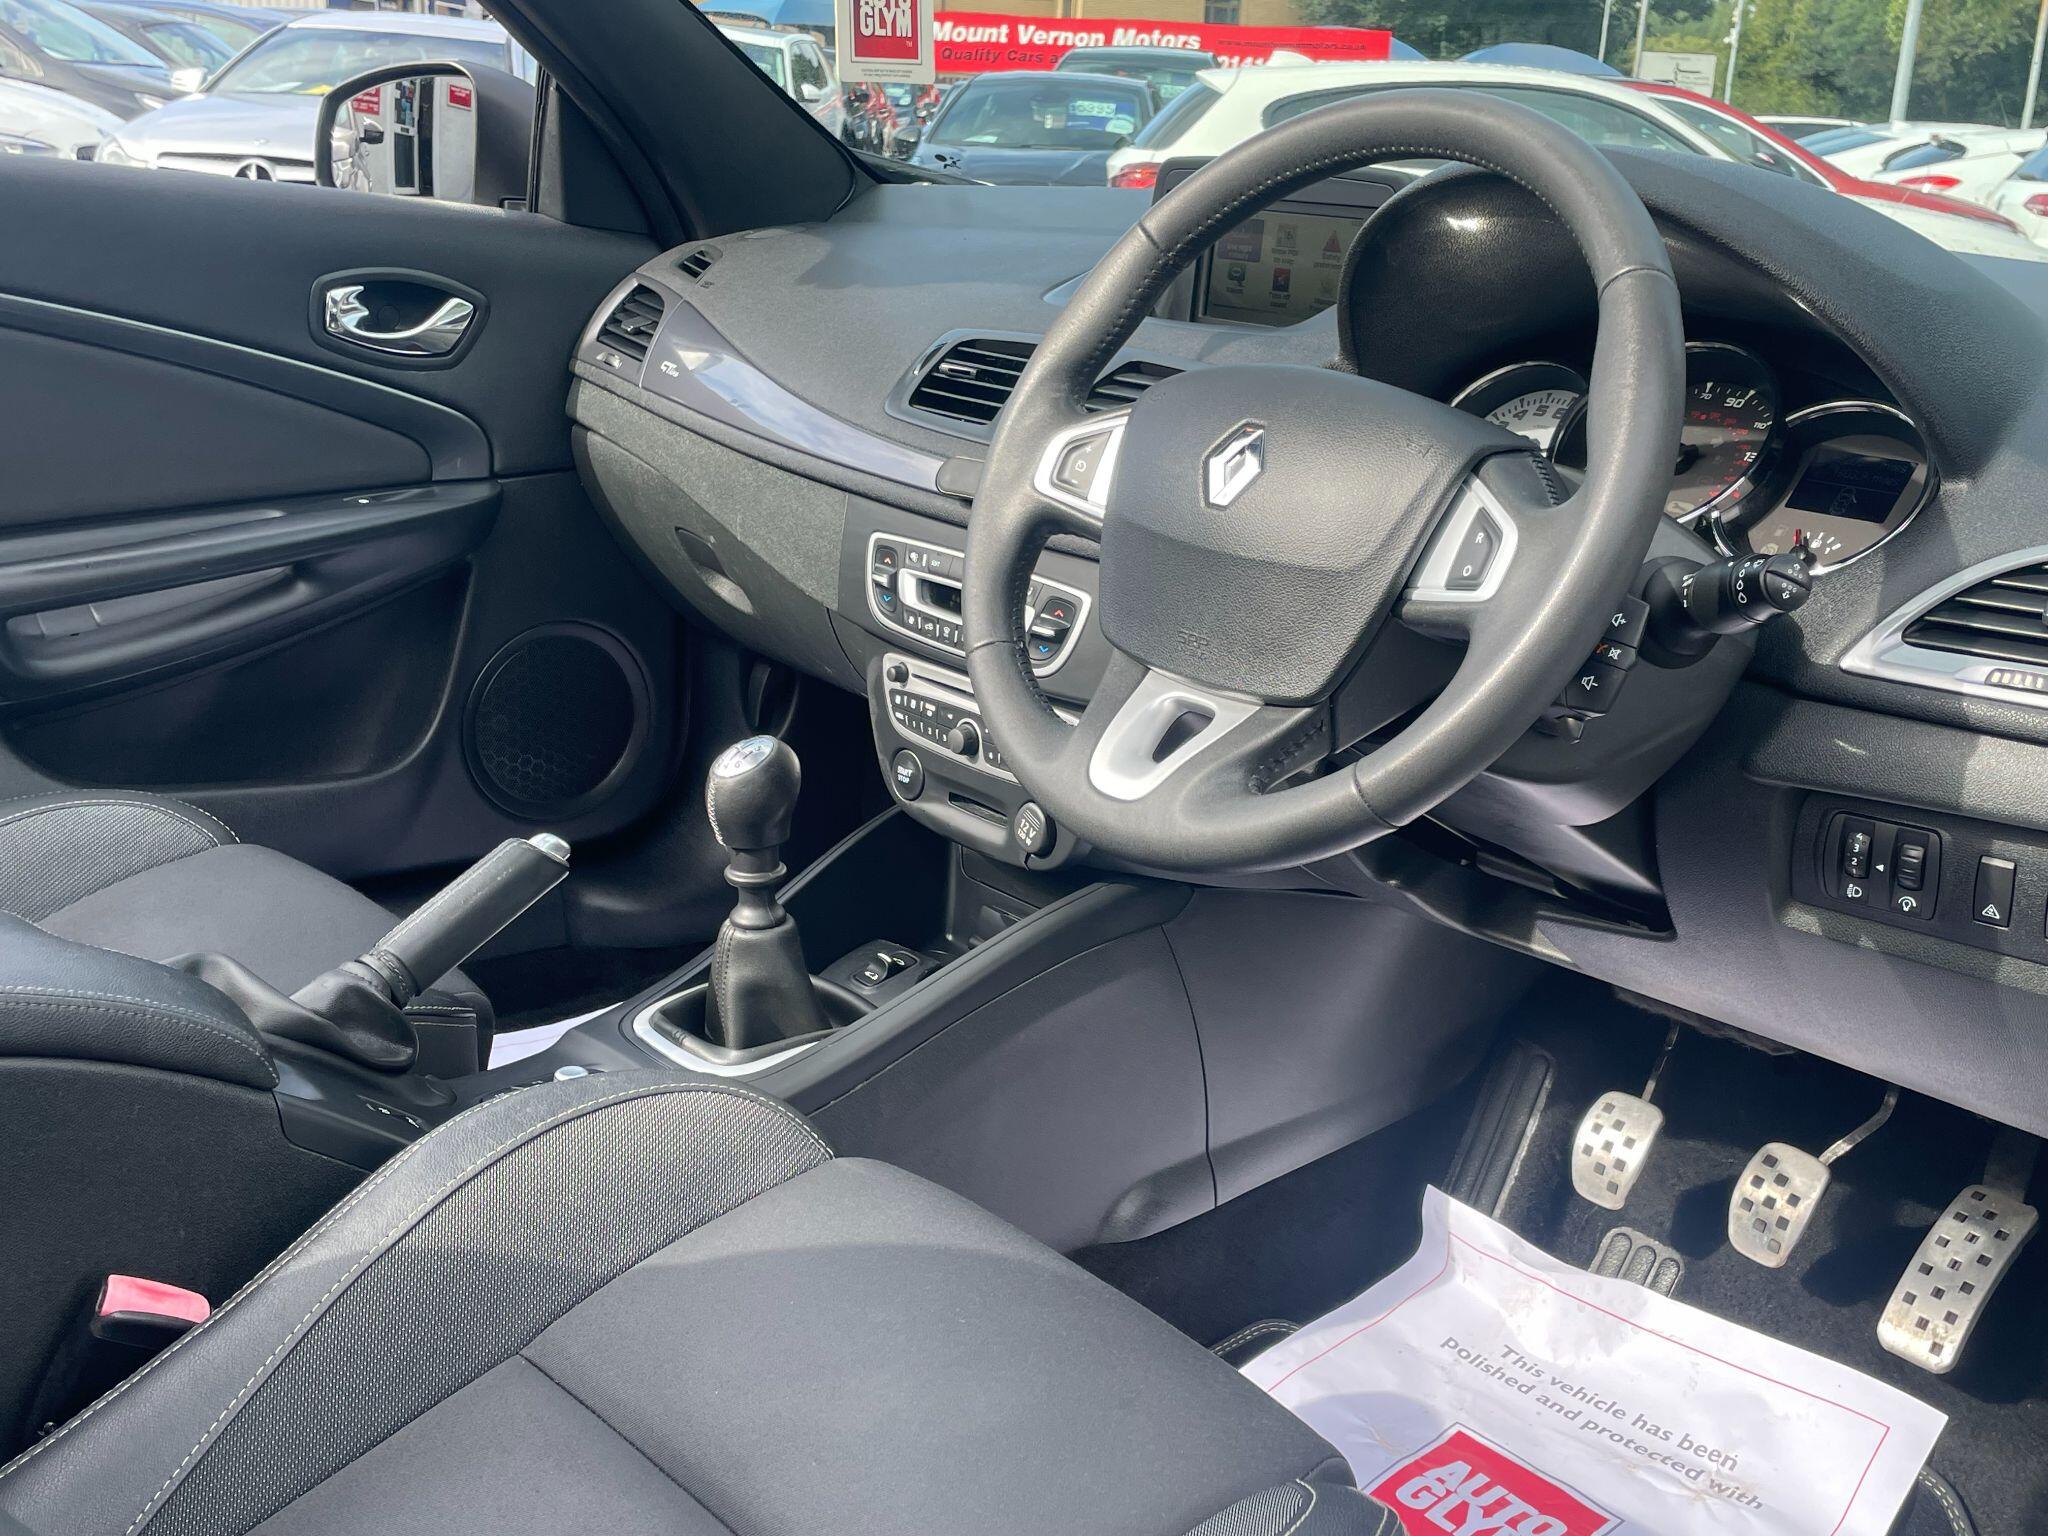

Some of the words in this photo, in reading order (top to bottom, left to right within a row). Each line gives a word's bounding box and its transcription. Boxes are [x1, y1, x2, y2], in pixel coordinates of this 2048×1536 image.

[860, 5, 912, 37] GLYM
[933, 21, 1009, 43] Mount
[1017, 24, 1105, 47] Vernon
[1112, 28, 1202, 50] Motors
[941, 47, 1001, 63] Quality
[1007, 50, 1043, 63] Cars
[1724, 397, 1745, 408] 90
[1533, 405, 1549, 417] 5
[1753, 421, 1767, 429] 110
[1475, 532, 1484, 543] R
[1856, 832, 1863, 841] 4
[1852, 843, 1860, 853] 3
[1851, 857, 1858, 866] 2
[1500, 1344, 1544, 1378] This
[1550, 1375, 1627, 1420] vehicle
[1631, 1413, 1674, 1442] has
[1677, 1433, 1740, 1472] been
[1535, 1392, 1583, 1422] and
[1579, 1419, 1705, 1482] protected
[1709, 1477, 1764, 1511] with
[1421, 1460, 1568, 1536] AUTO
[1395, 1475, 1514, 1536] GLY
